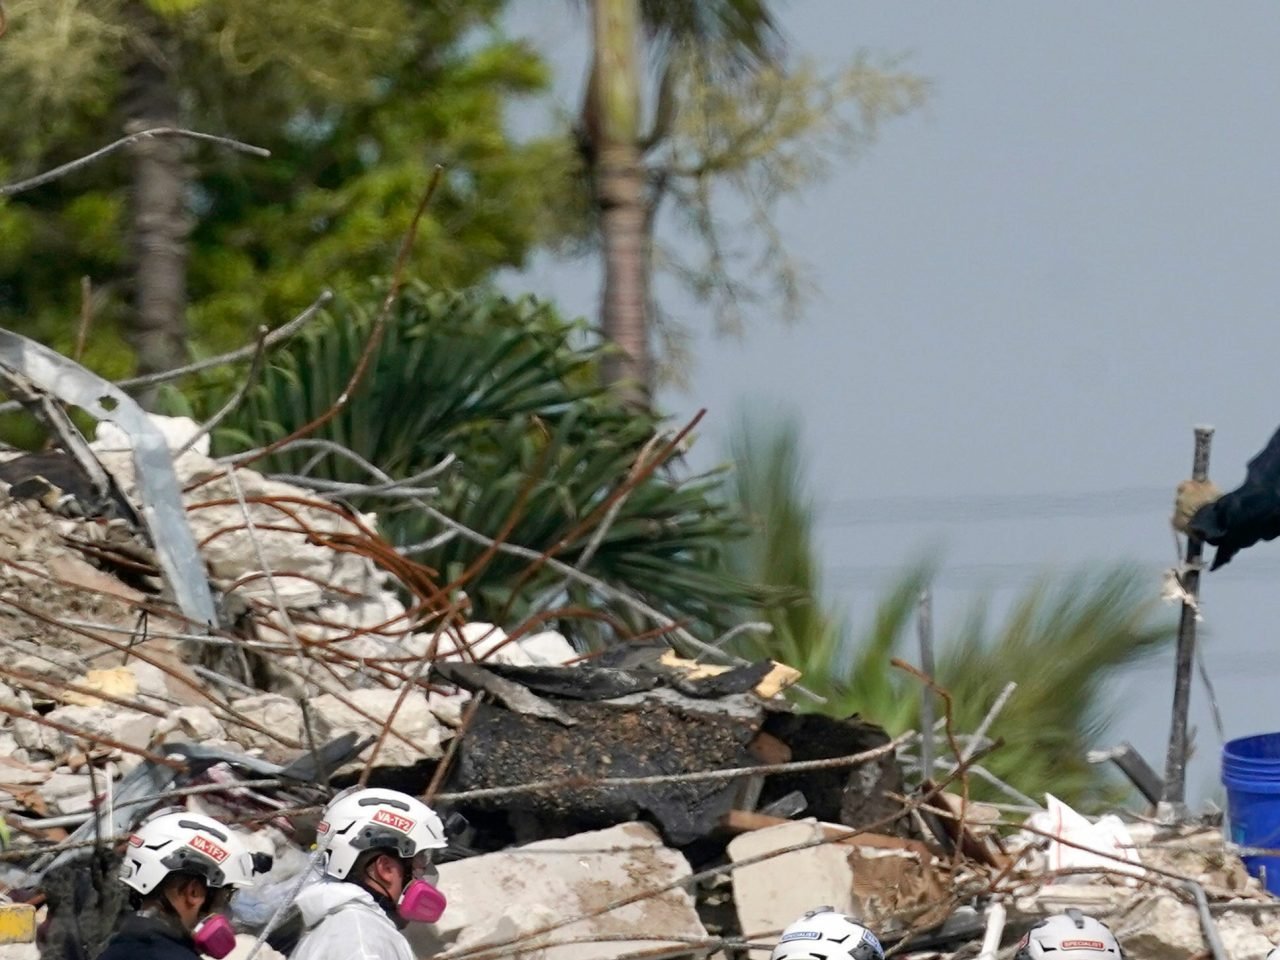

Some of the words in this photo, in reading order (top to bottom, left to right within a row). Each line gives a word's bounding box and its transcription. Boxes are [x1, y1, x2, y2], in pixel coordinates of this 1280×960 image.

[377, 811, 410, 831] VA-TF2
[193, 836, 225, 862] VA-TF2
[1064, 941, 1102, 949] SPECIALIST
